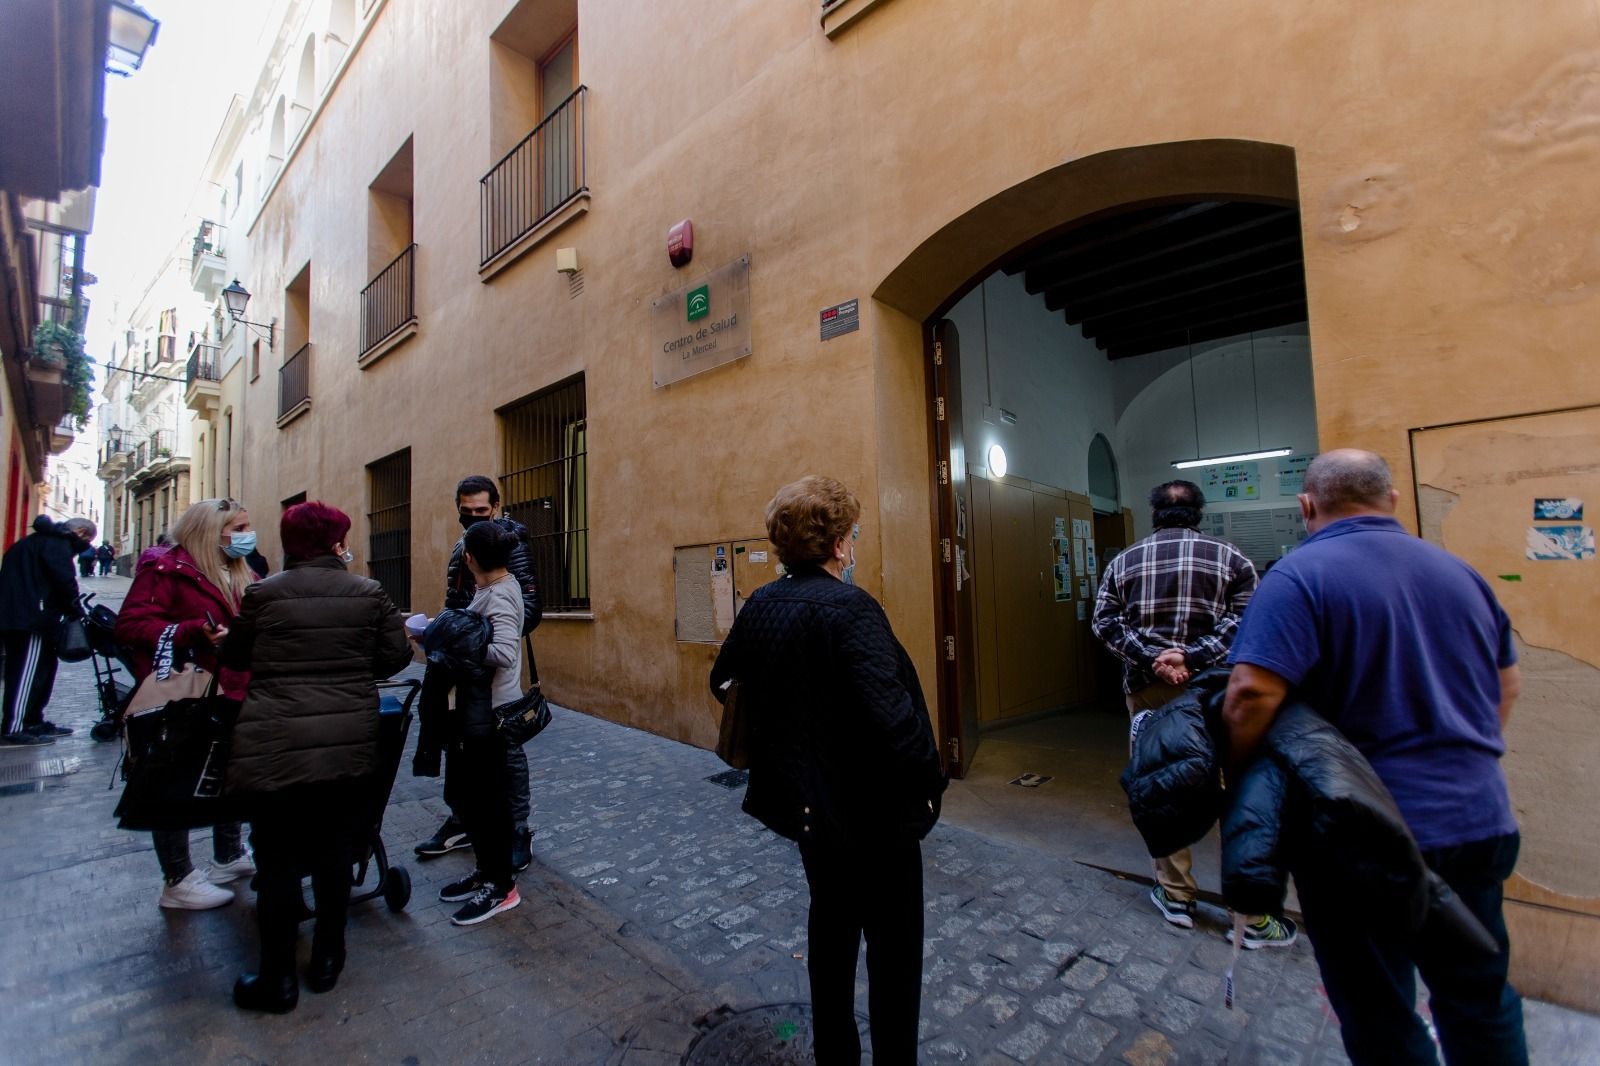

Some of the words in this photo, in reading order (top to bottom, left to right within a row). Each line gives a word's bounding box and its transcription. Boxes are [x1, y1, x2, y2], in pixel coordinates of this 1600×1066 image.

[663, 334, 693, 353] Centro
[695, 327, 708, 341] de
[710, 313, 737, 334] Salud
[681, 351, 690, 360] La
